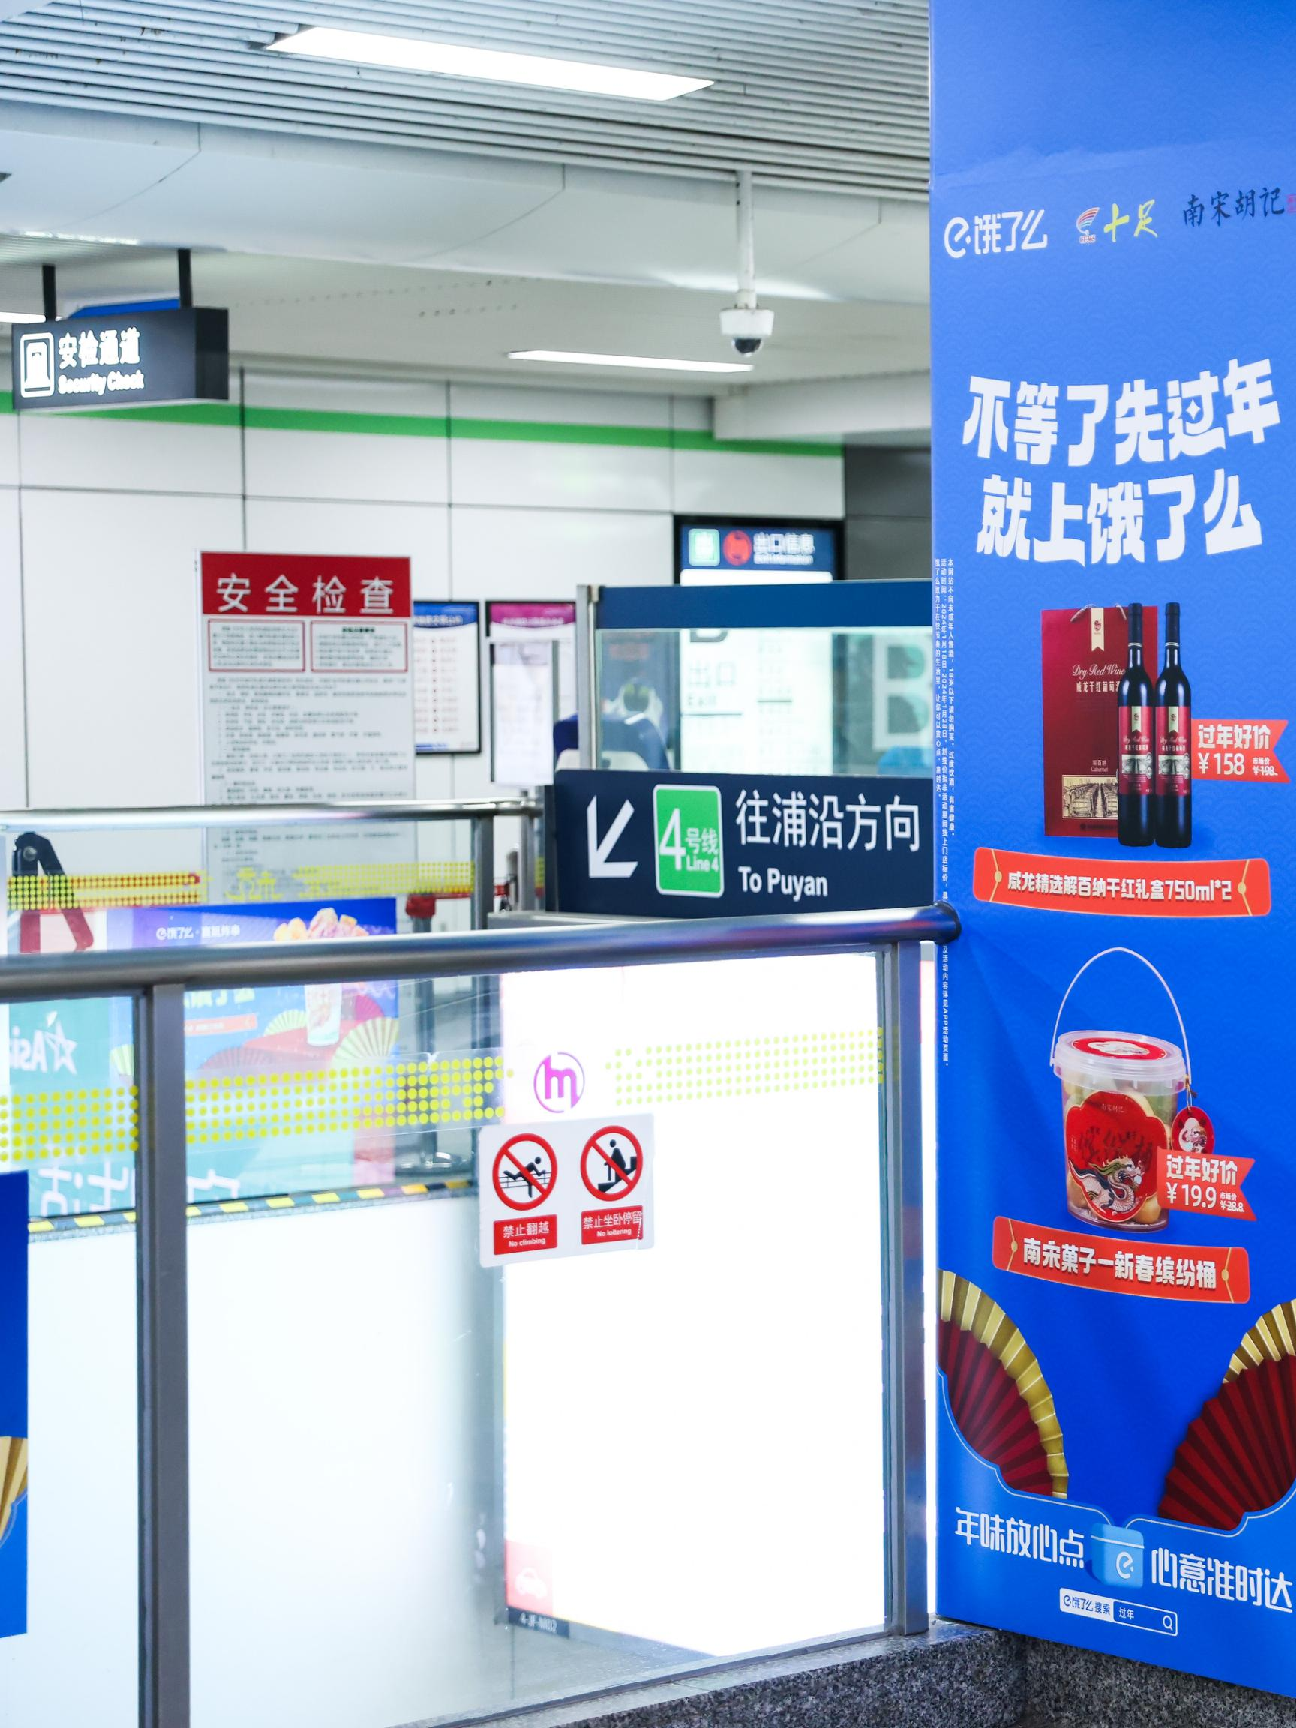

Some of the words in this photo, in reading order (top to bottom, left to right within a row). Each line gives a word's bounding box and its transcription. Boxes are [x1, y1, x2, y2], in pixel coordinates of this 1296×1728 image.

[1104, 199, 1158, 242] 十足
[1183, 187, 1285, 227] 南宋胡记
[58, 327, 141, 369] 安检通道
[58, 373, 106, 395] Security
[107, 369, 145, 391] Check
[962, 358, 1281, 467] 不等了先过年
[976, 467, 1262, 567] 就上饿了么
[216, 573, 393, 614] 安全检查
[1198, 724, 1271, 750] 过年好价
[736, 790, 920, 851] 往浦沿方向
[686, 857, 710, 872] Line
[711, 858, 719, 872] 4
[738, 866, 762, 893] To
[767, 868, 828, 902] Puyan
[1166, 1154, 1238, 1185] 过年好价
[503, 1220, 549, 1239] 禁止翻越
[583, 1210, 642, 1229] 禁止坐卧停留
[508, 1240, 518, 1248] No
[519, 1237, 546, 1248] climbing
[955, 1507, 1085, 1569] 年味放心点
[1151, 1547, 1293, 1613] 心意准时达
[1119, 1607, 1134, 1619] 过年
